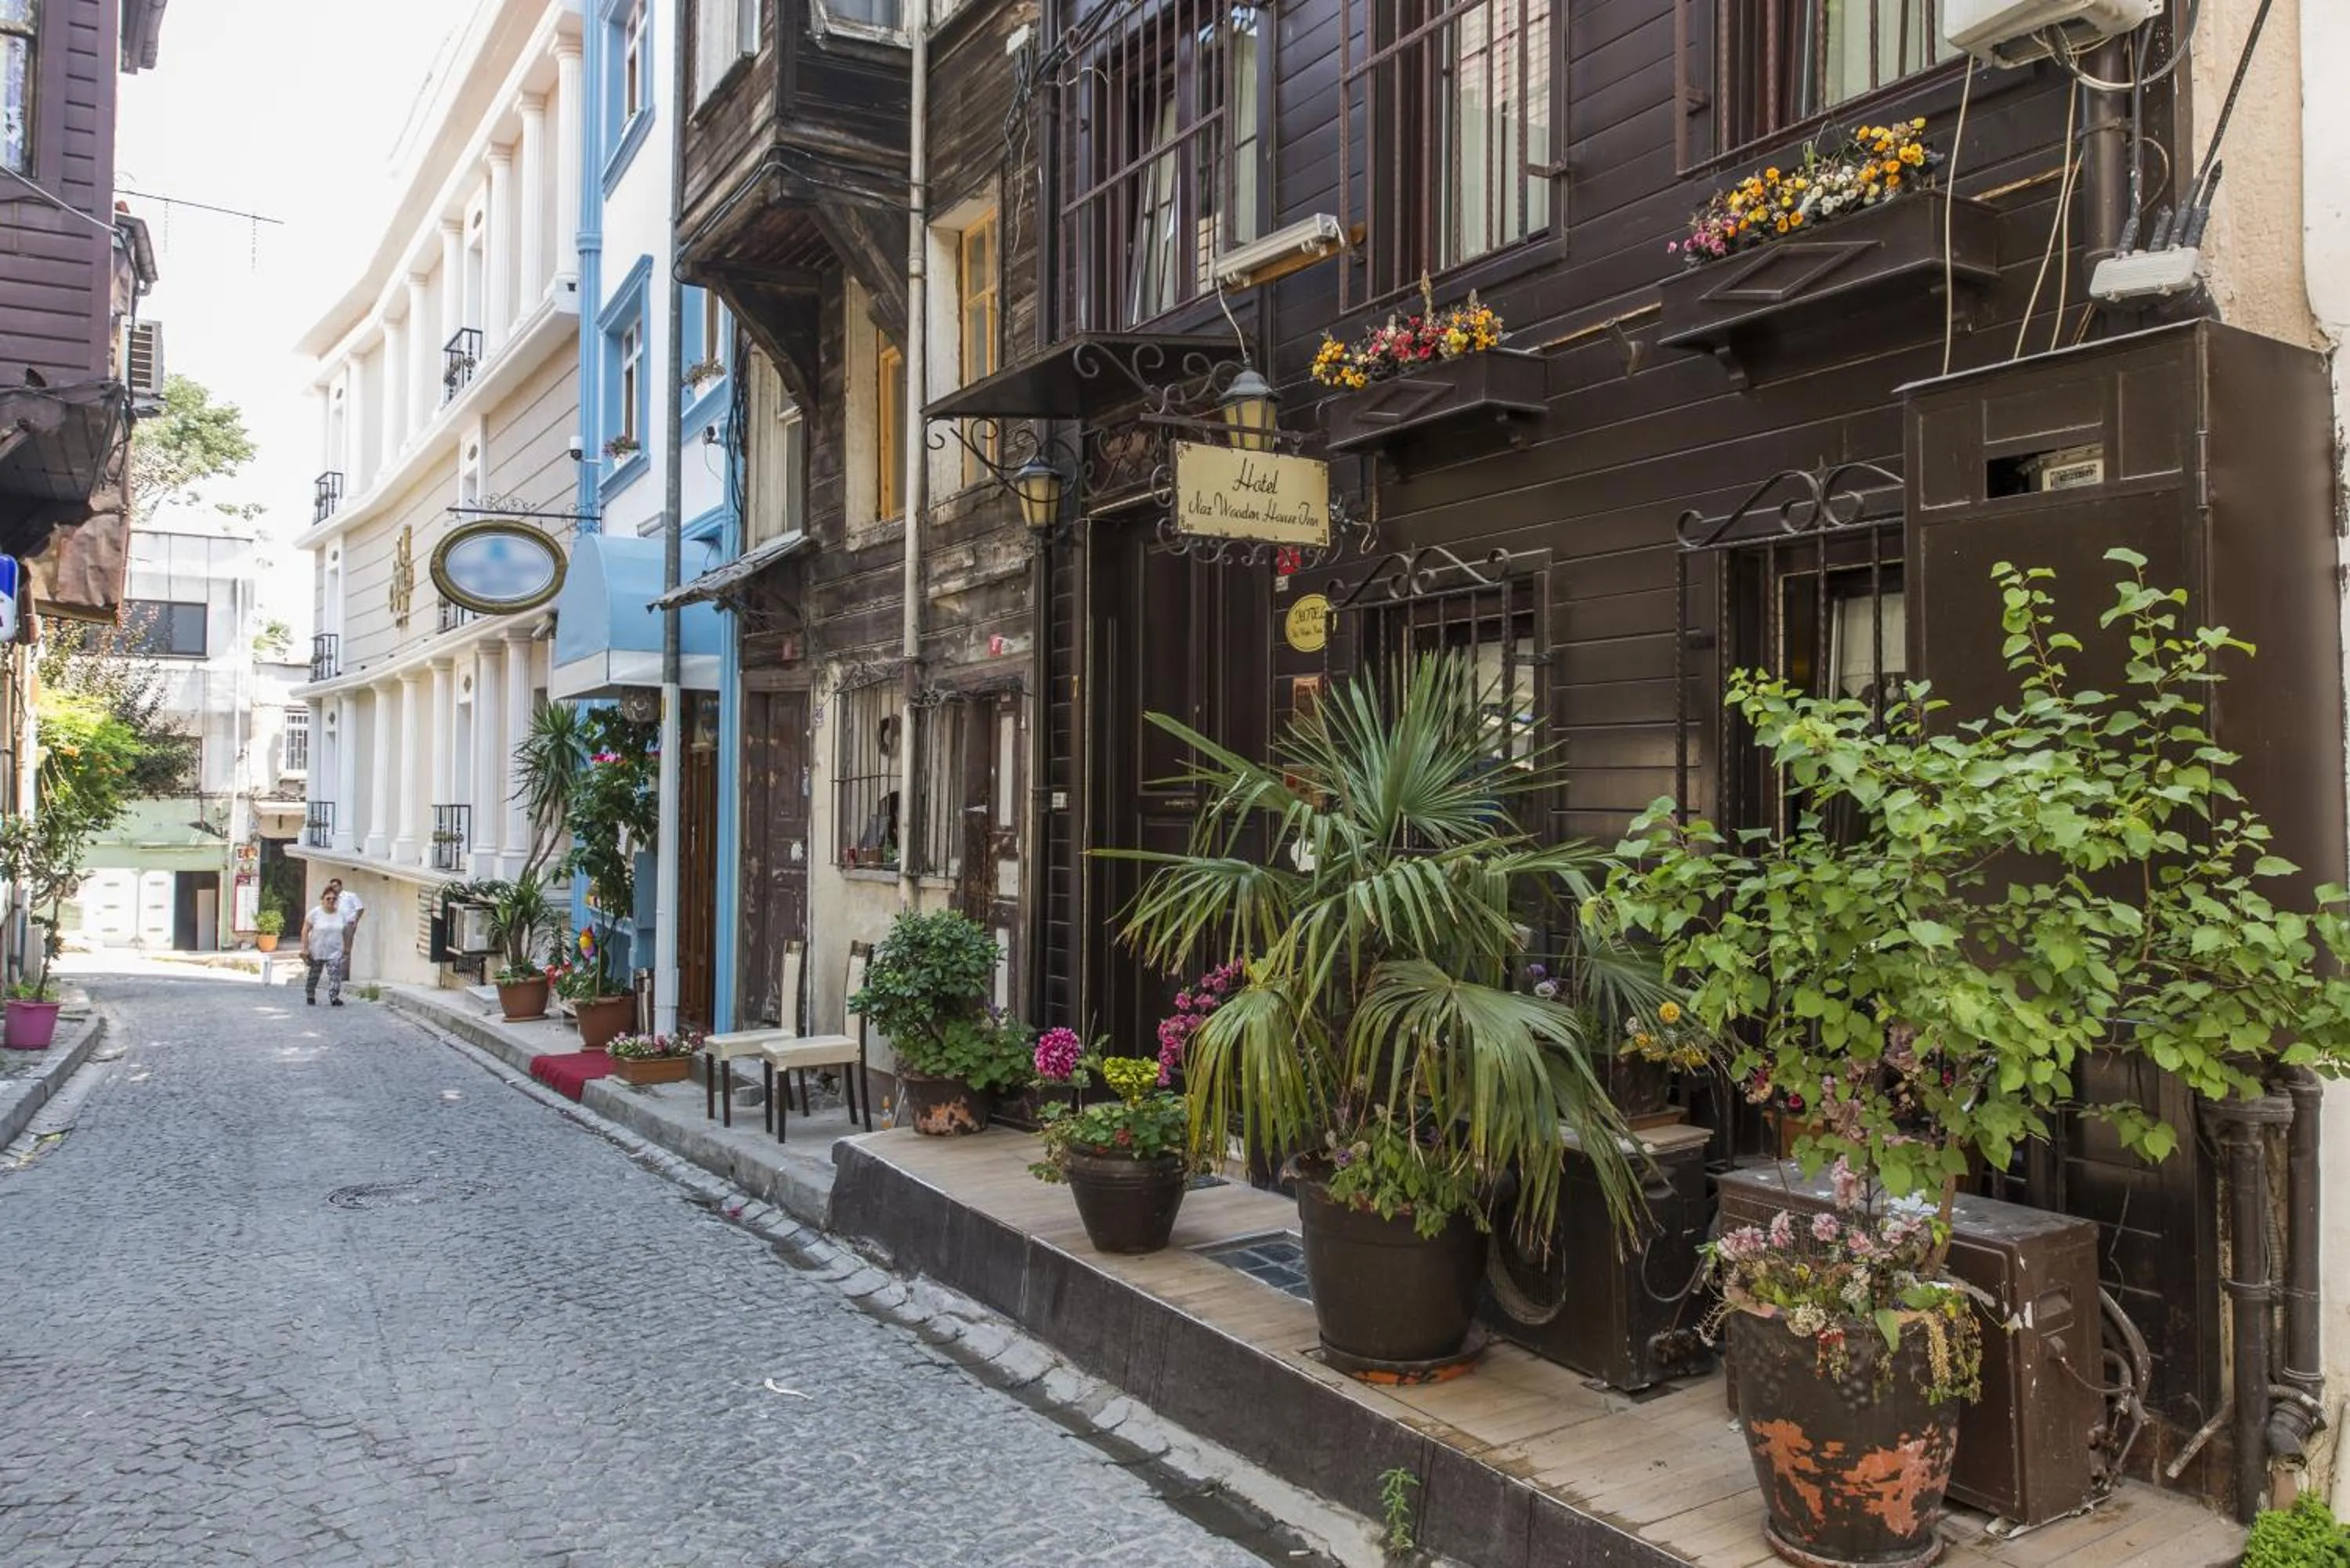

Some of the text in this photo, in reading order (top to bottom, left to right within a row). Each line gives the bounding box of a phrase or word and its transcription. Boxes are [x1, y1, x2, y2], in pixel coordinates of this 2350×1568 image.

[1232, 457, 1278, 494] Hotel
[1188, 490, 1213, 515] Naz
[1298, 501, 1319, 527] Inn
